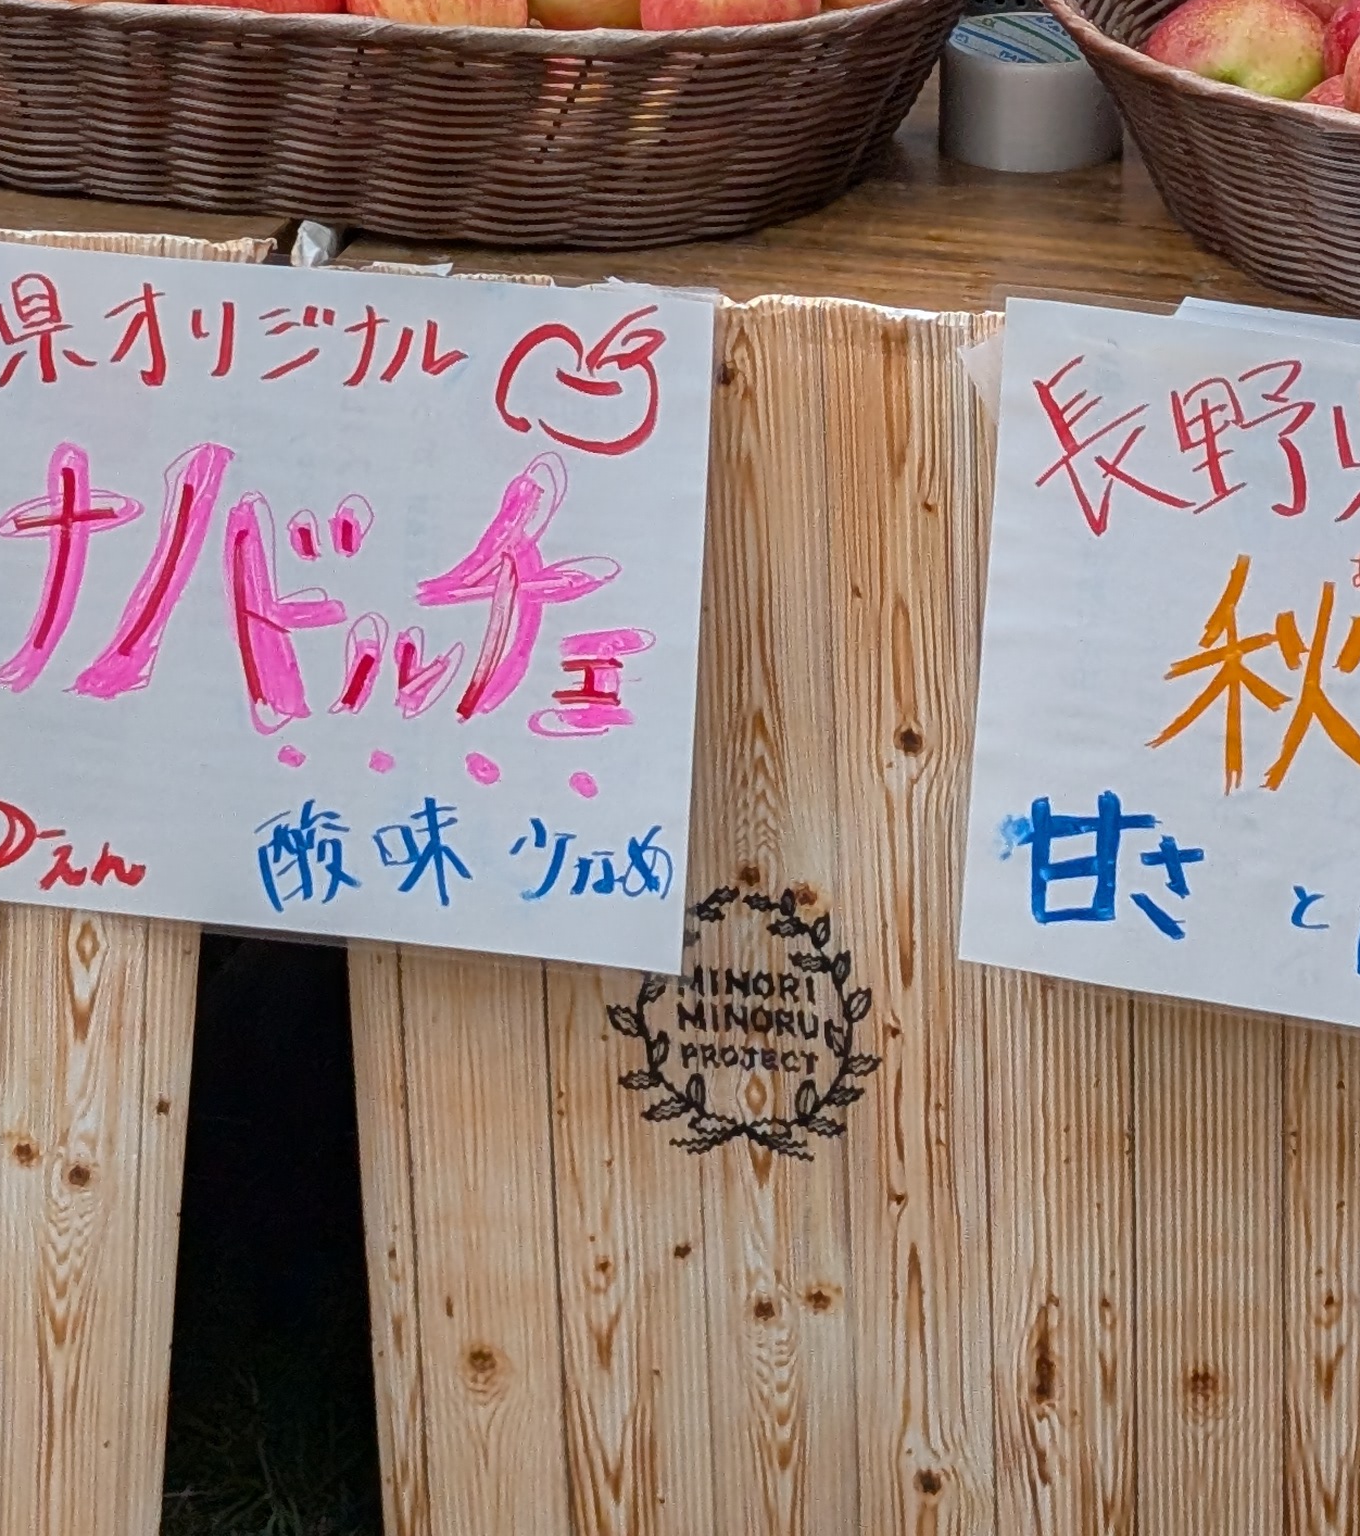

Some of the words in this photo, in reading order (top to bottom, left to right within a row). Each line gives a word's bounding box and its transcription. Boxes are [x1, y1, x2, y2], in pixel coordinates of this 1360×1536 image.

[676, 965, 817, 1005] MINORI
[676, 999, 820, 1041] MINORU
[681, 1042, 818, 1075] PROJECT
